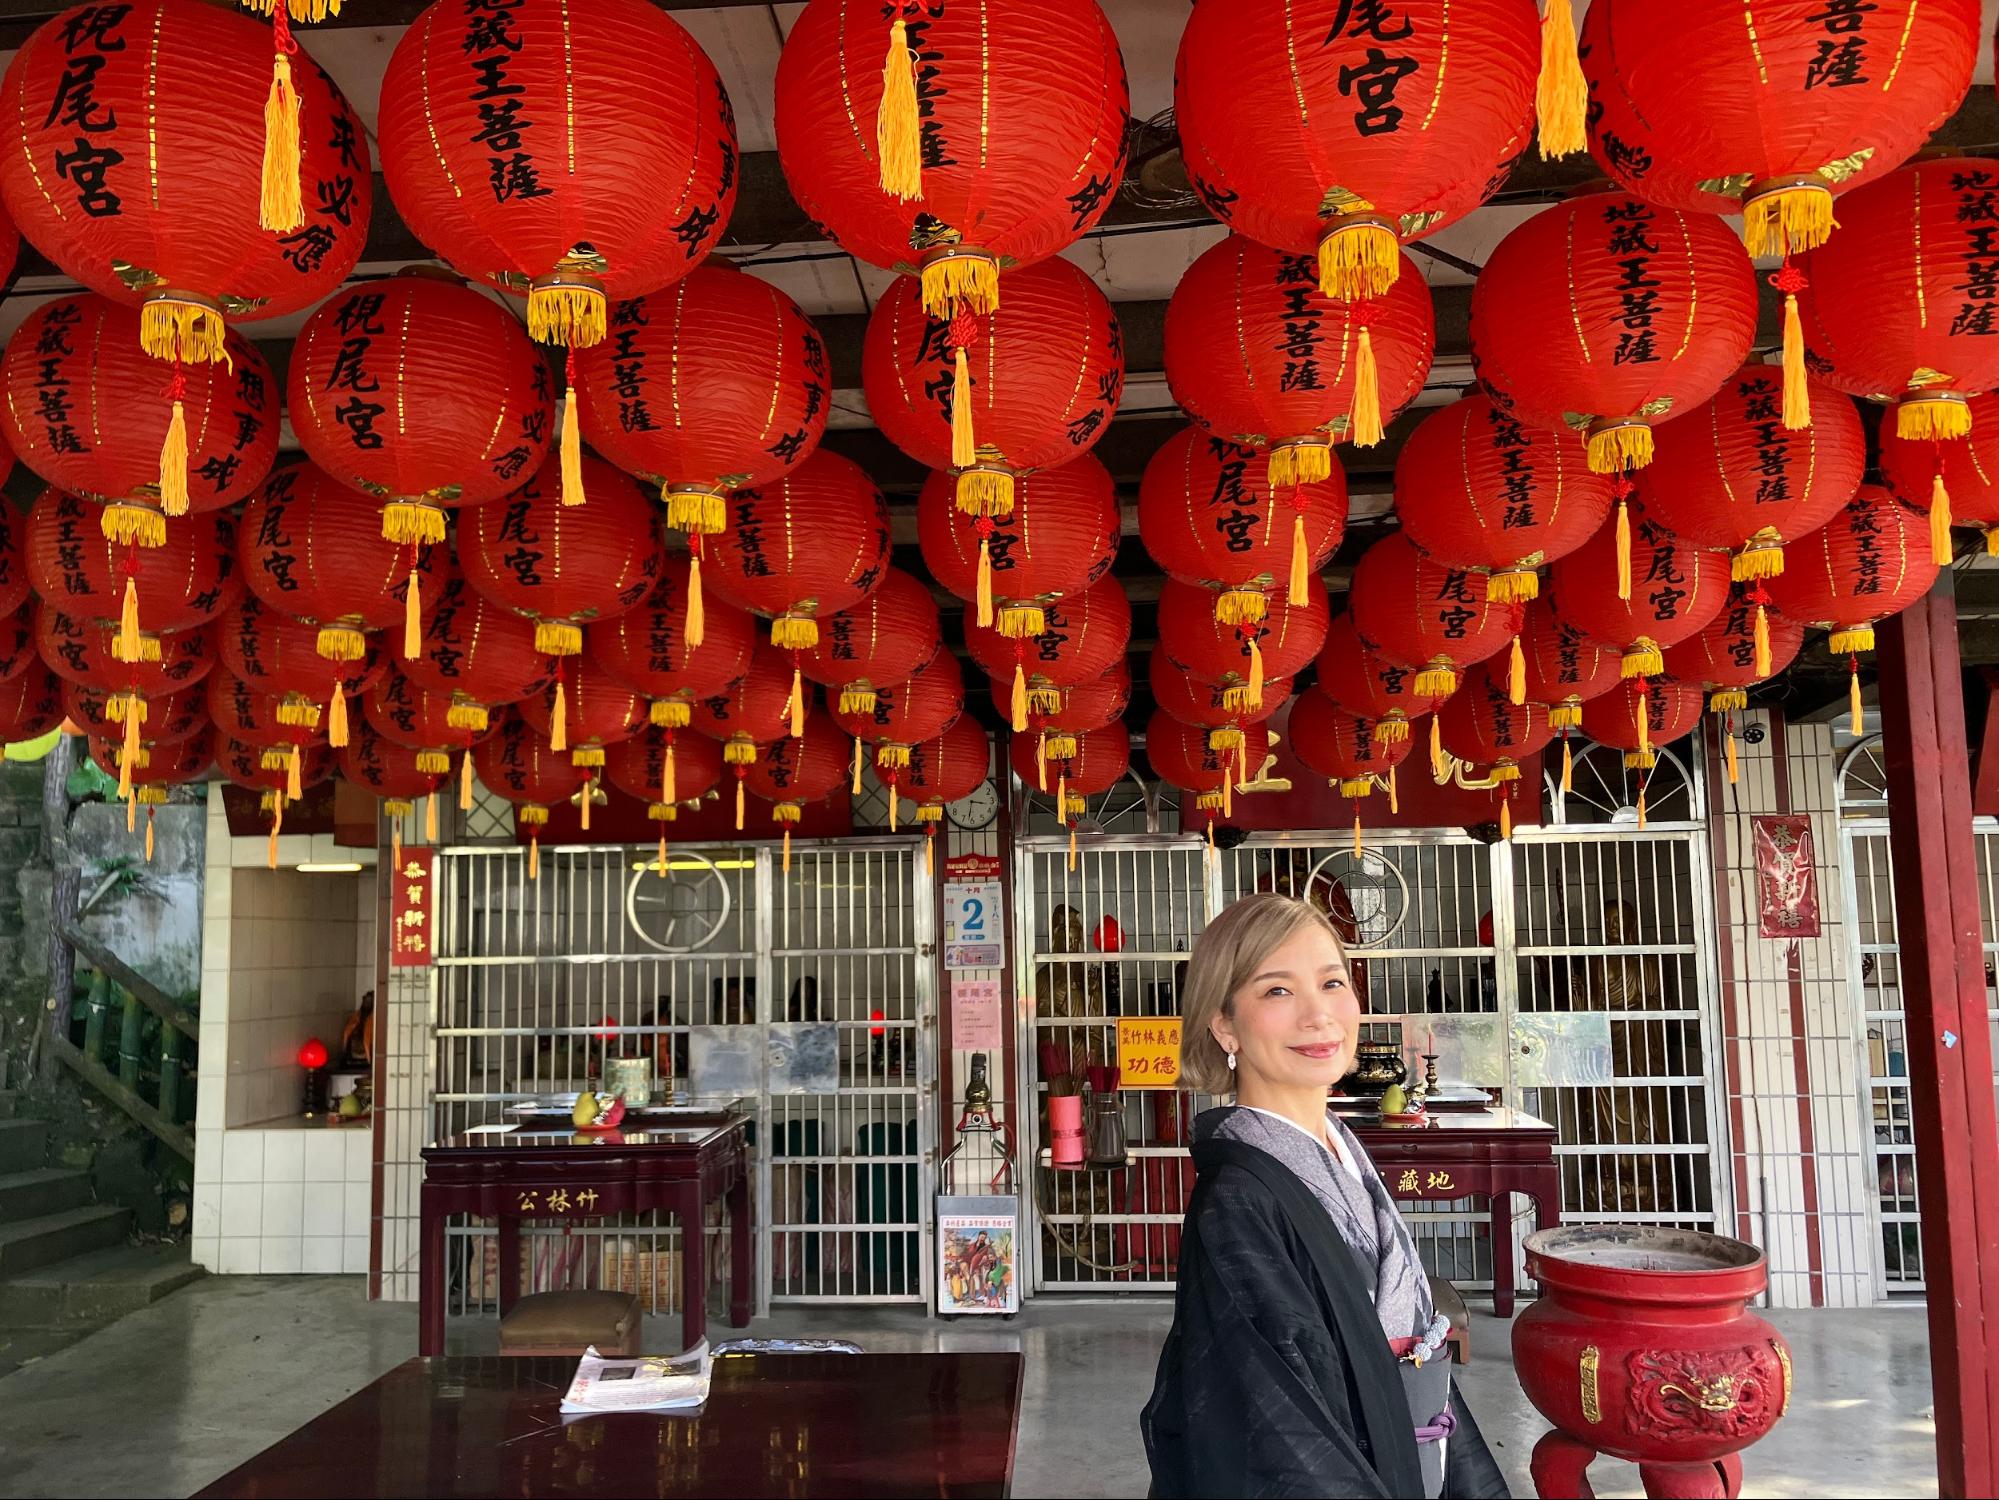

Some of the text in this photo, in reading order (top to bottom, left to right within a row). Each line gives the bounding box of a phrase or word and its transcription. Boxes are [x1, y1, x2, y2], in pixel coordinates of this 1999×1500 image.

[1600, 201, 1664, 366] 地藏王菩薩
[34, 303, 91, 456] 地藏王菩薩
[962, 898, 984, 930] 2
[1128, 1057, 1176, 1074] 功德
